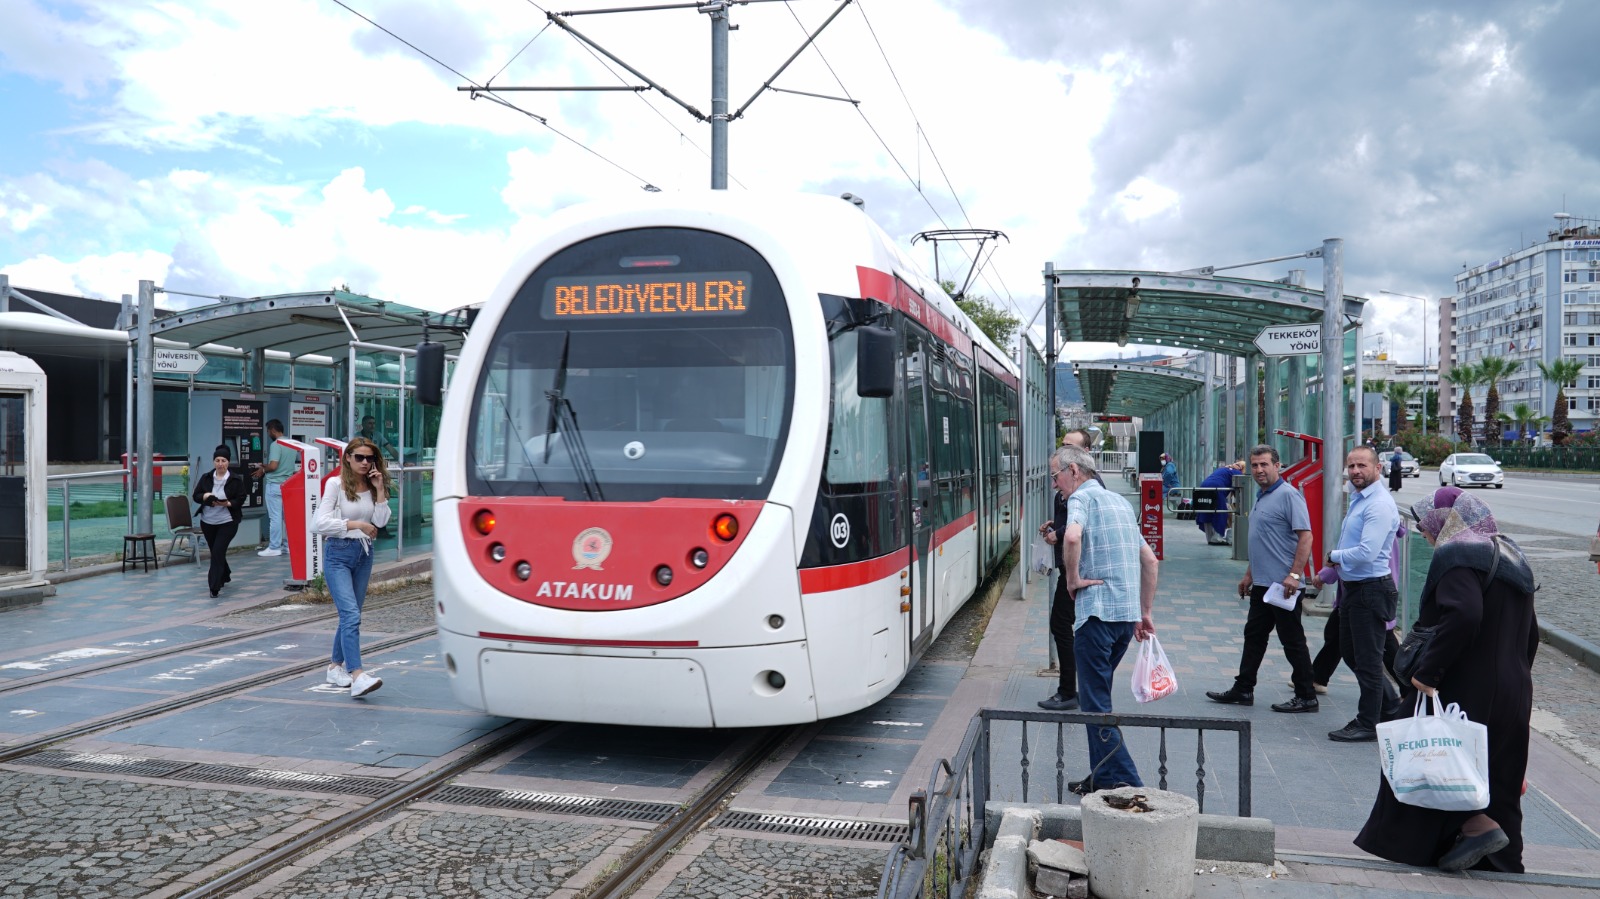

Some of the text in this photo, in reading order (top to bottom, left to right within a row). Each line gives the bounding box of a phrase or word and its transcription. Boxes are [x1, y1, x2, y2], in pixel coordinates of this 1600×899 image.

[555, 280, 746, 315] BELEDİYEEVLERİ
[1268, 328, 1318, 340] TEKKEKÖY
[1290, 340, 1318, 350] YÖNÜ
[157, 350, 199, 360] ÜNİVERSİTE
[157, 361, 178, 369] YÖNÜ
[833, 521, 847, 539] 03
[535, 581, 634, 601] ATAKUM
